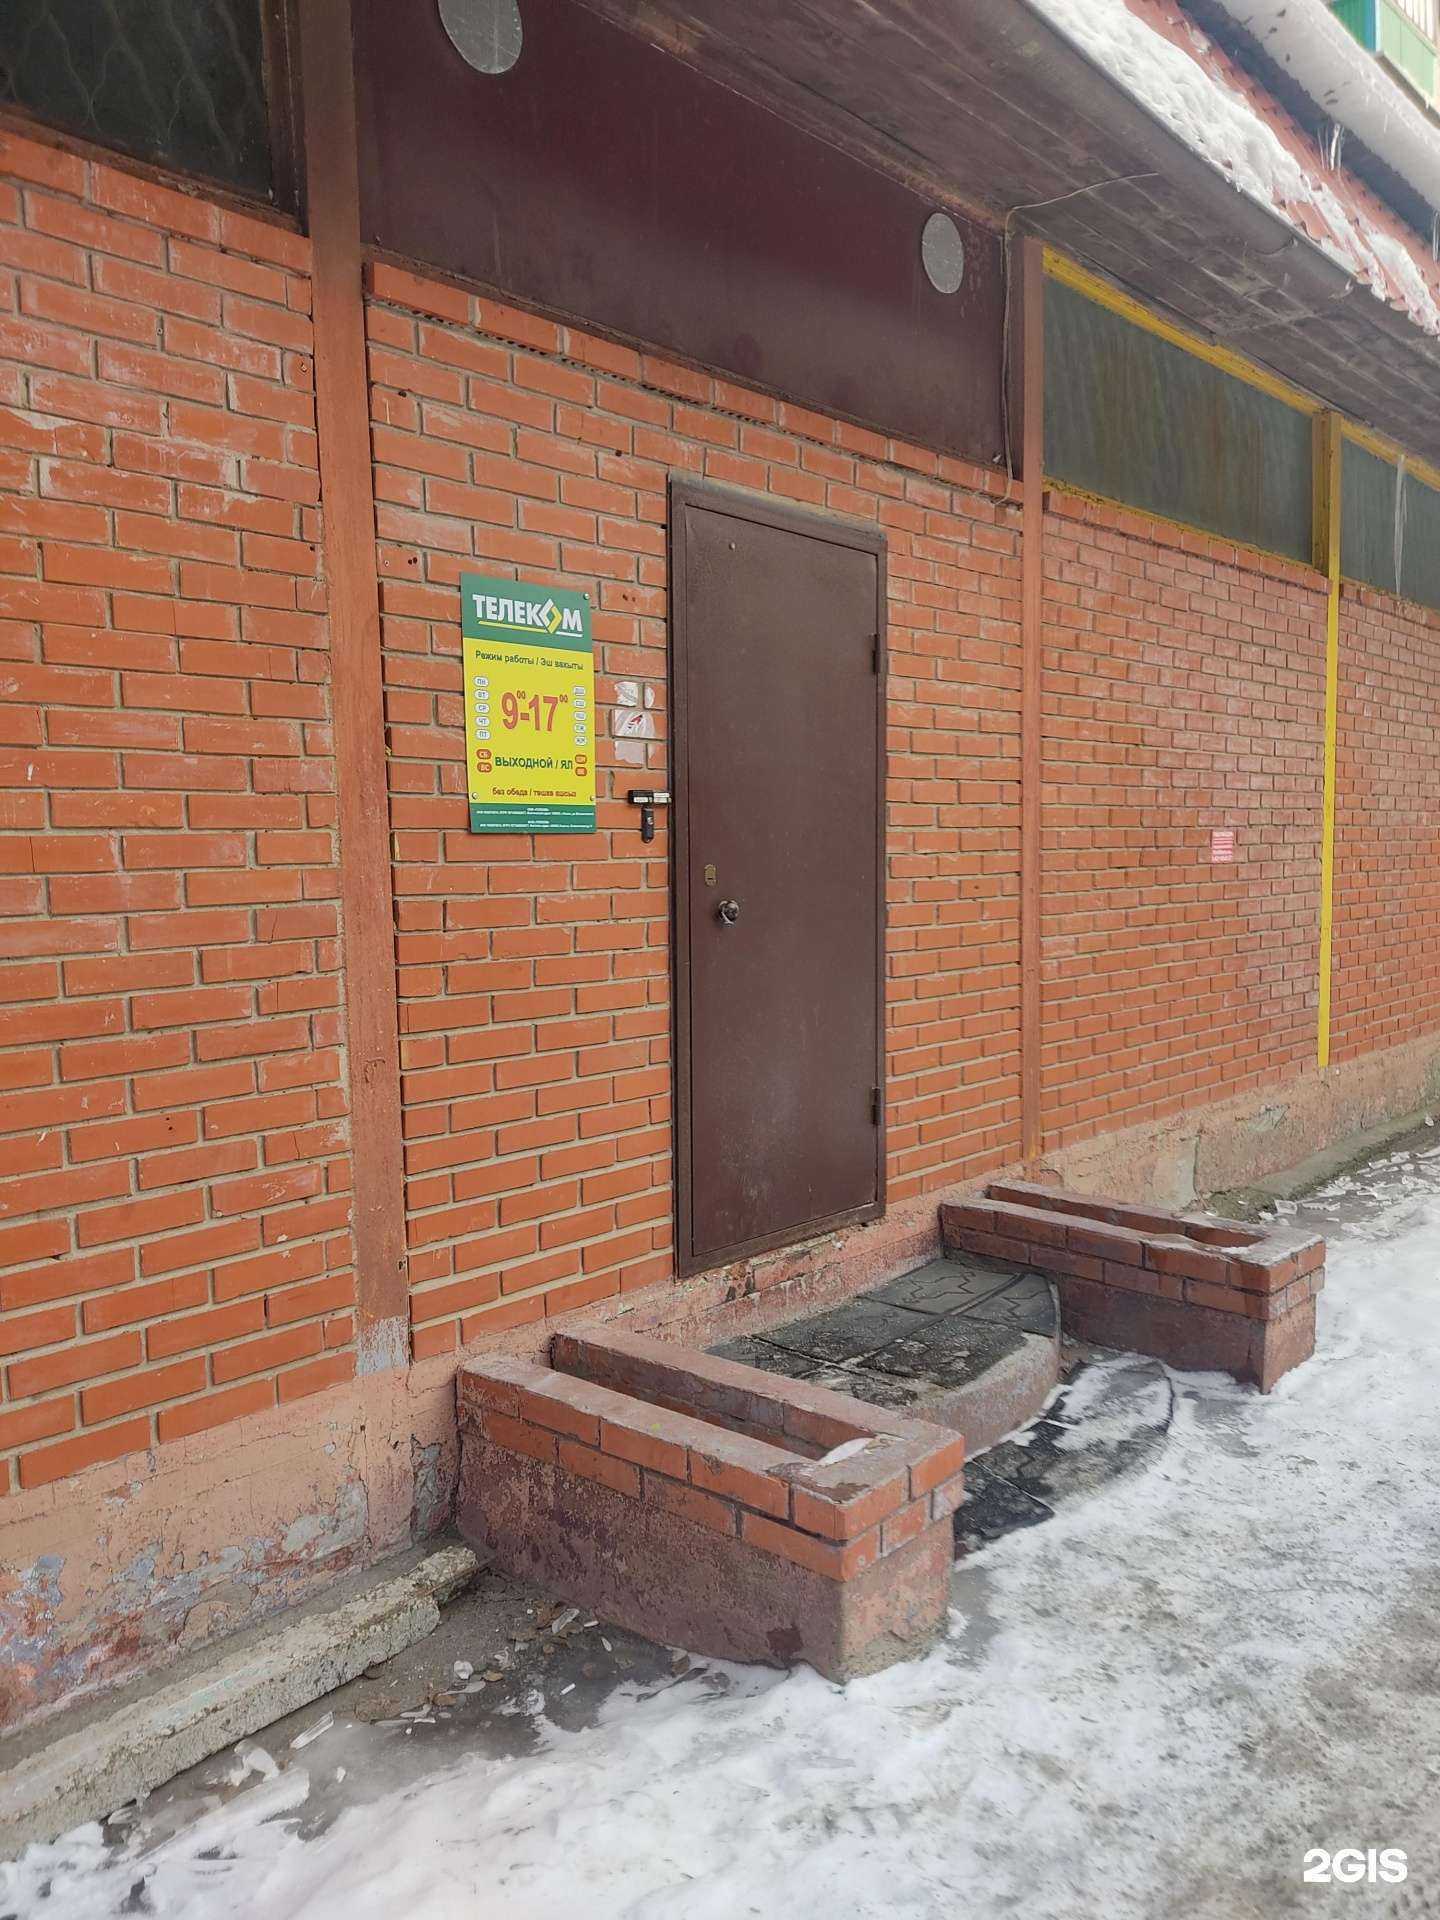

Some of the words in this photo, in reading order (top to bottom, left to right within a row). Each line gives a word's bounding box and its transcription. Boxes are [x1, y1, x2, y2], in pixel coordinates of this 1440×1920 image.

[472, 594, 583, 633] ТЕЛЕКОМ
[475, 650, 502, 661] Режим
[504, 655, 534, 665] работы
[495, 757, 553, 769] ВЫХОДНОЙ
[561, 760, 573, 770] ЯЛ
